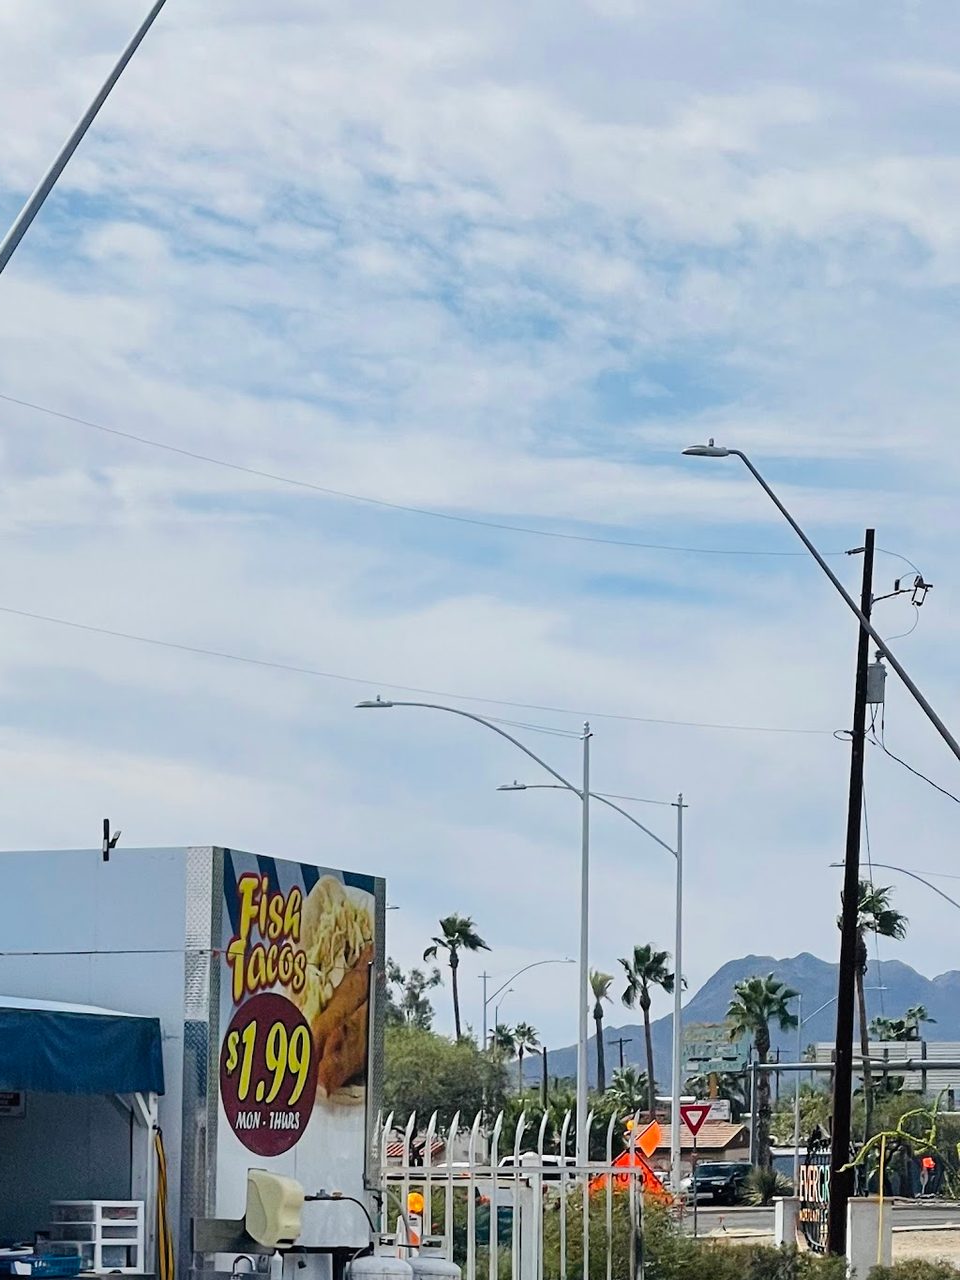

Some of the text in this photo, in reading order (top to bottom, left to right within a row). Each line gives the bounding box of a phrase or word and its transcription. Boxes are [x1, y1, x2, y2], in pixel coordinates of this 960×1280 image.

[238, 874, 303, 941] Fish
[227, 937, 307, 1003] Tacos
[225, 1020, 311, 1107] $1.99
[235, 1111, 260, 1130] MON
[269, 1111, 300, 1130] THURS
